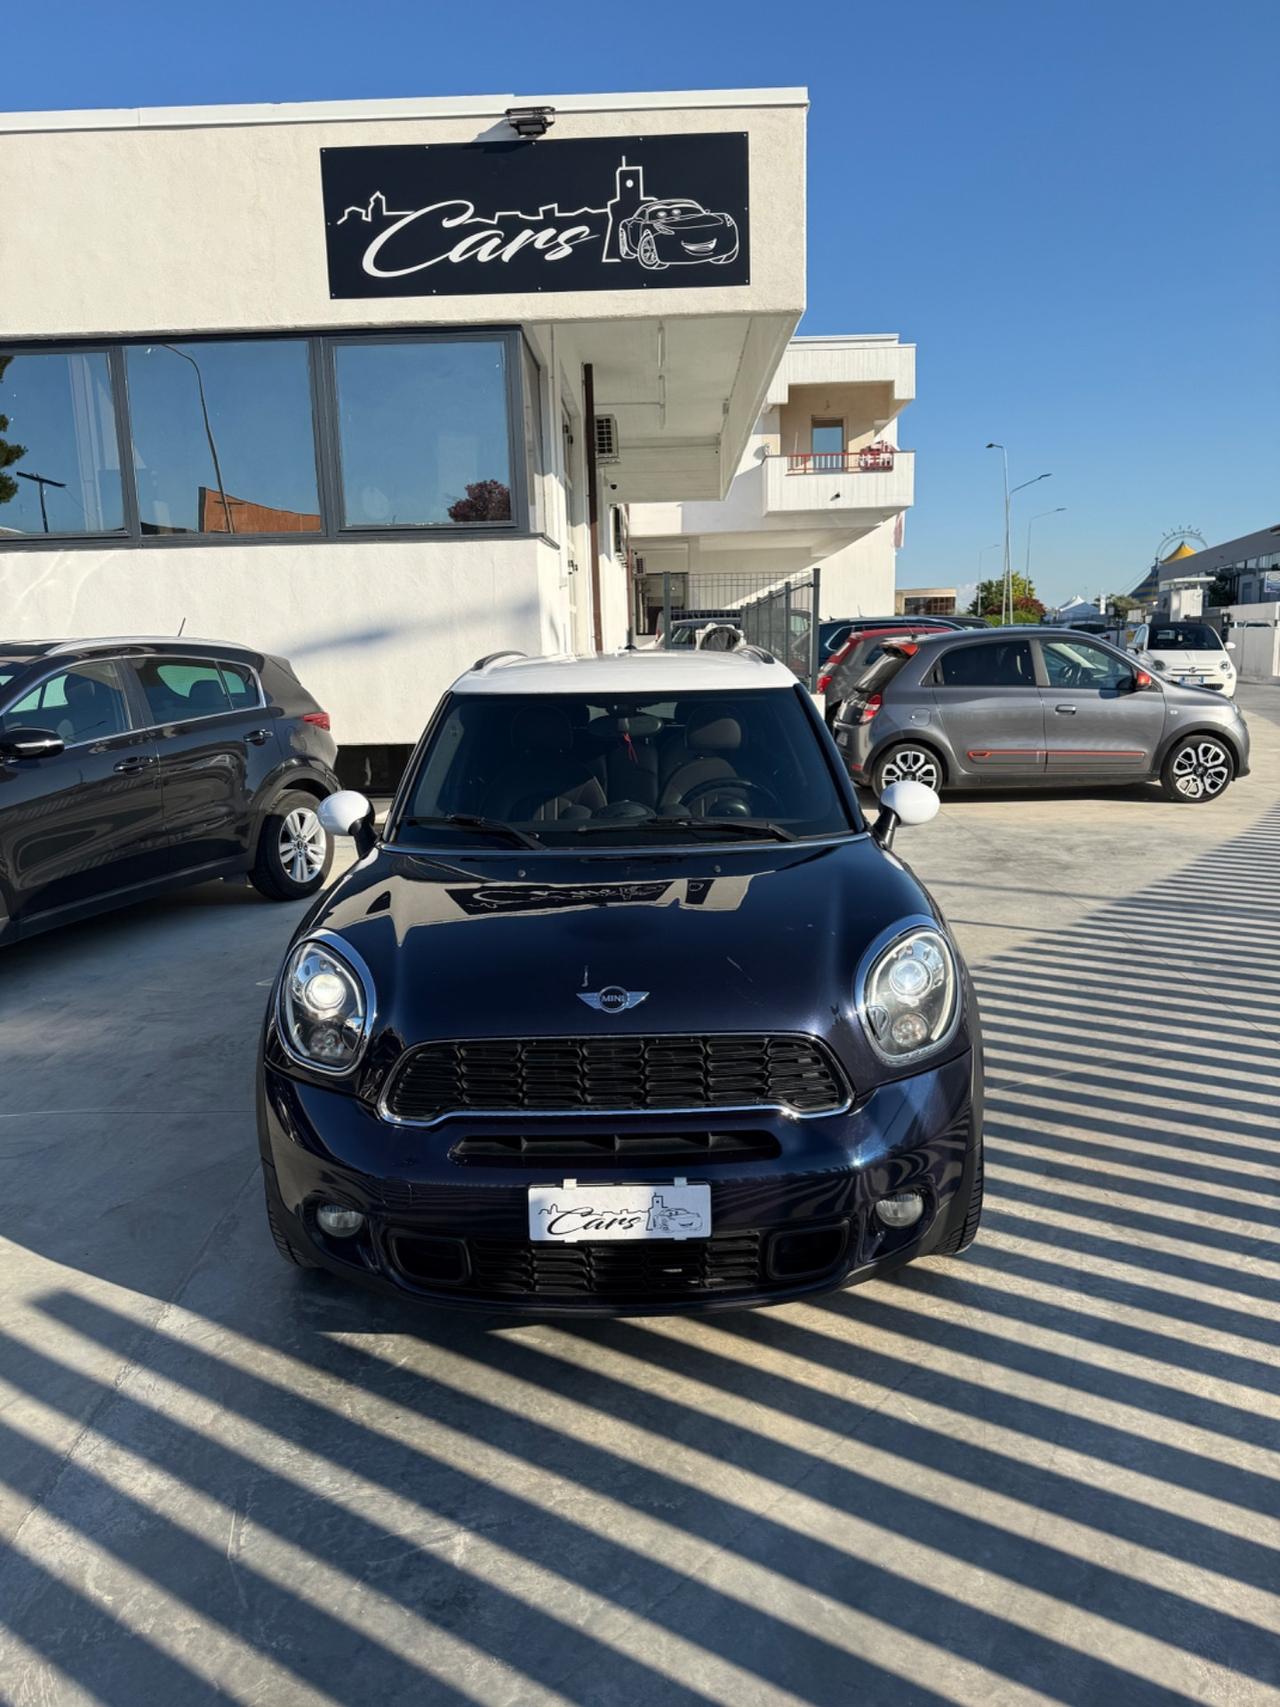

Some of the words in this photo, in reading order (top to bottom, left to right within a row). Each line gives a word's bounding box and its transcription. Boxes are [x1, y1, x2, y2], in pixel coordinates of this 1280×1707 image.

[361, 200, 600, 278] Cars
[601, 994, 625, 1003] MINI
[547, 1207, 642, 1235] Cars
